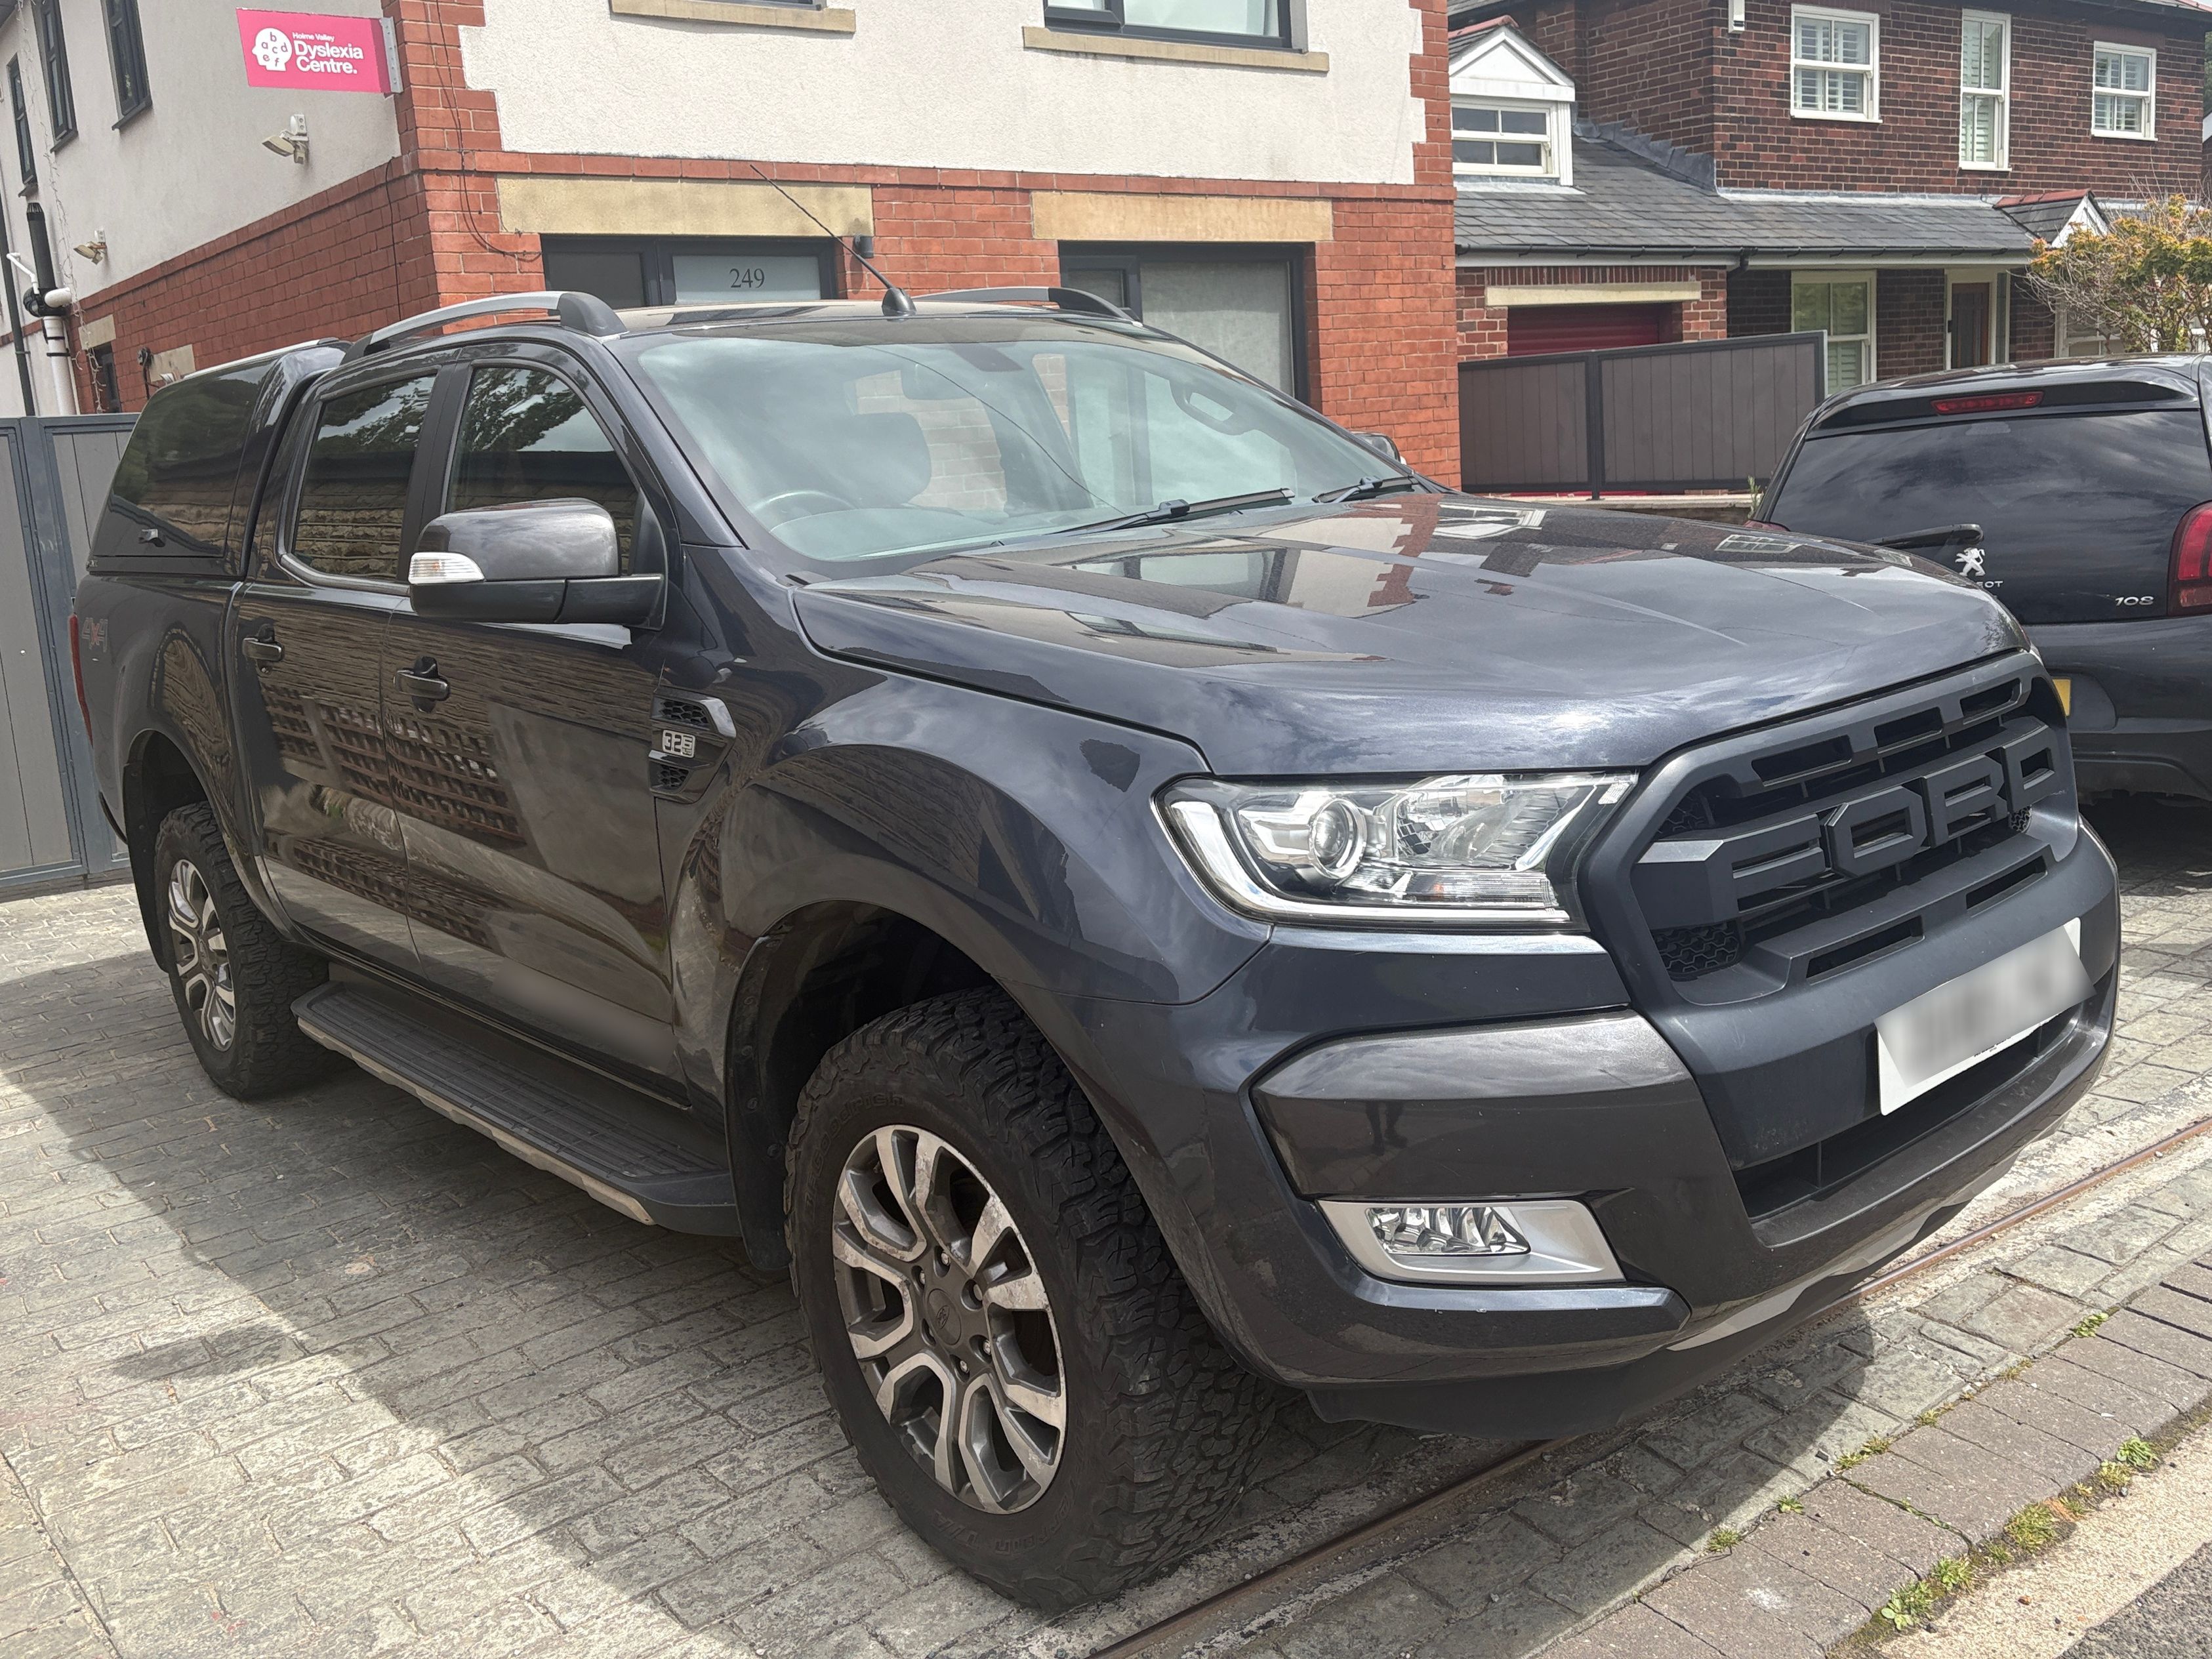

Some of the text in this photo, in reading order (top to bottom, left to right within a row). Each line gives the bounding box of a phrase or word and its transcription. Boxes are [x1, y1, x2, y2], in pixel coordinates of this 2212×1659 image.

[315, 33, 335, 42] Valley
[293, 40, 364, 59] Dyslexia
[296, 55, 358, 75] Centre.
[729, 268, 766, 289] 249
[2114, 596, 2154, 607] 108
[1706, 715, 2063, 923] FORD
